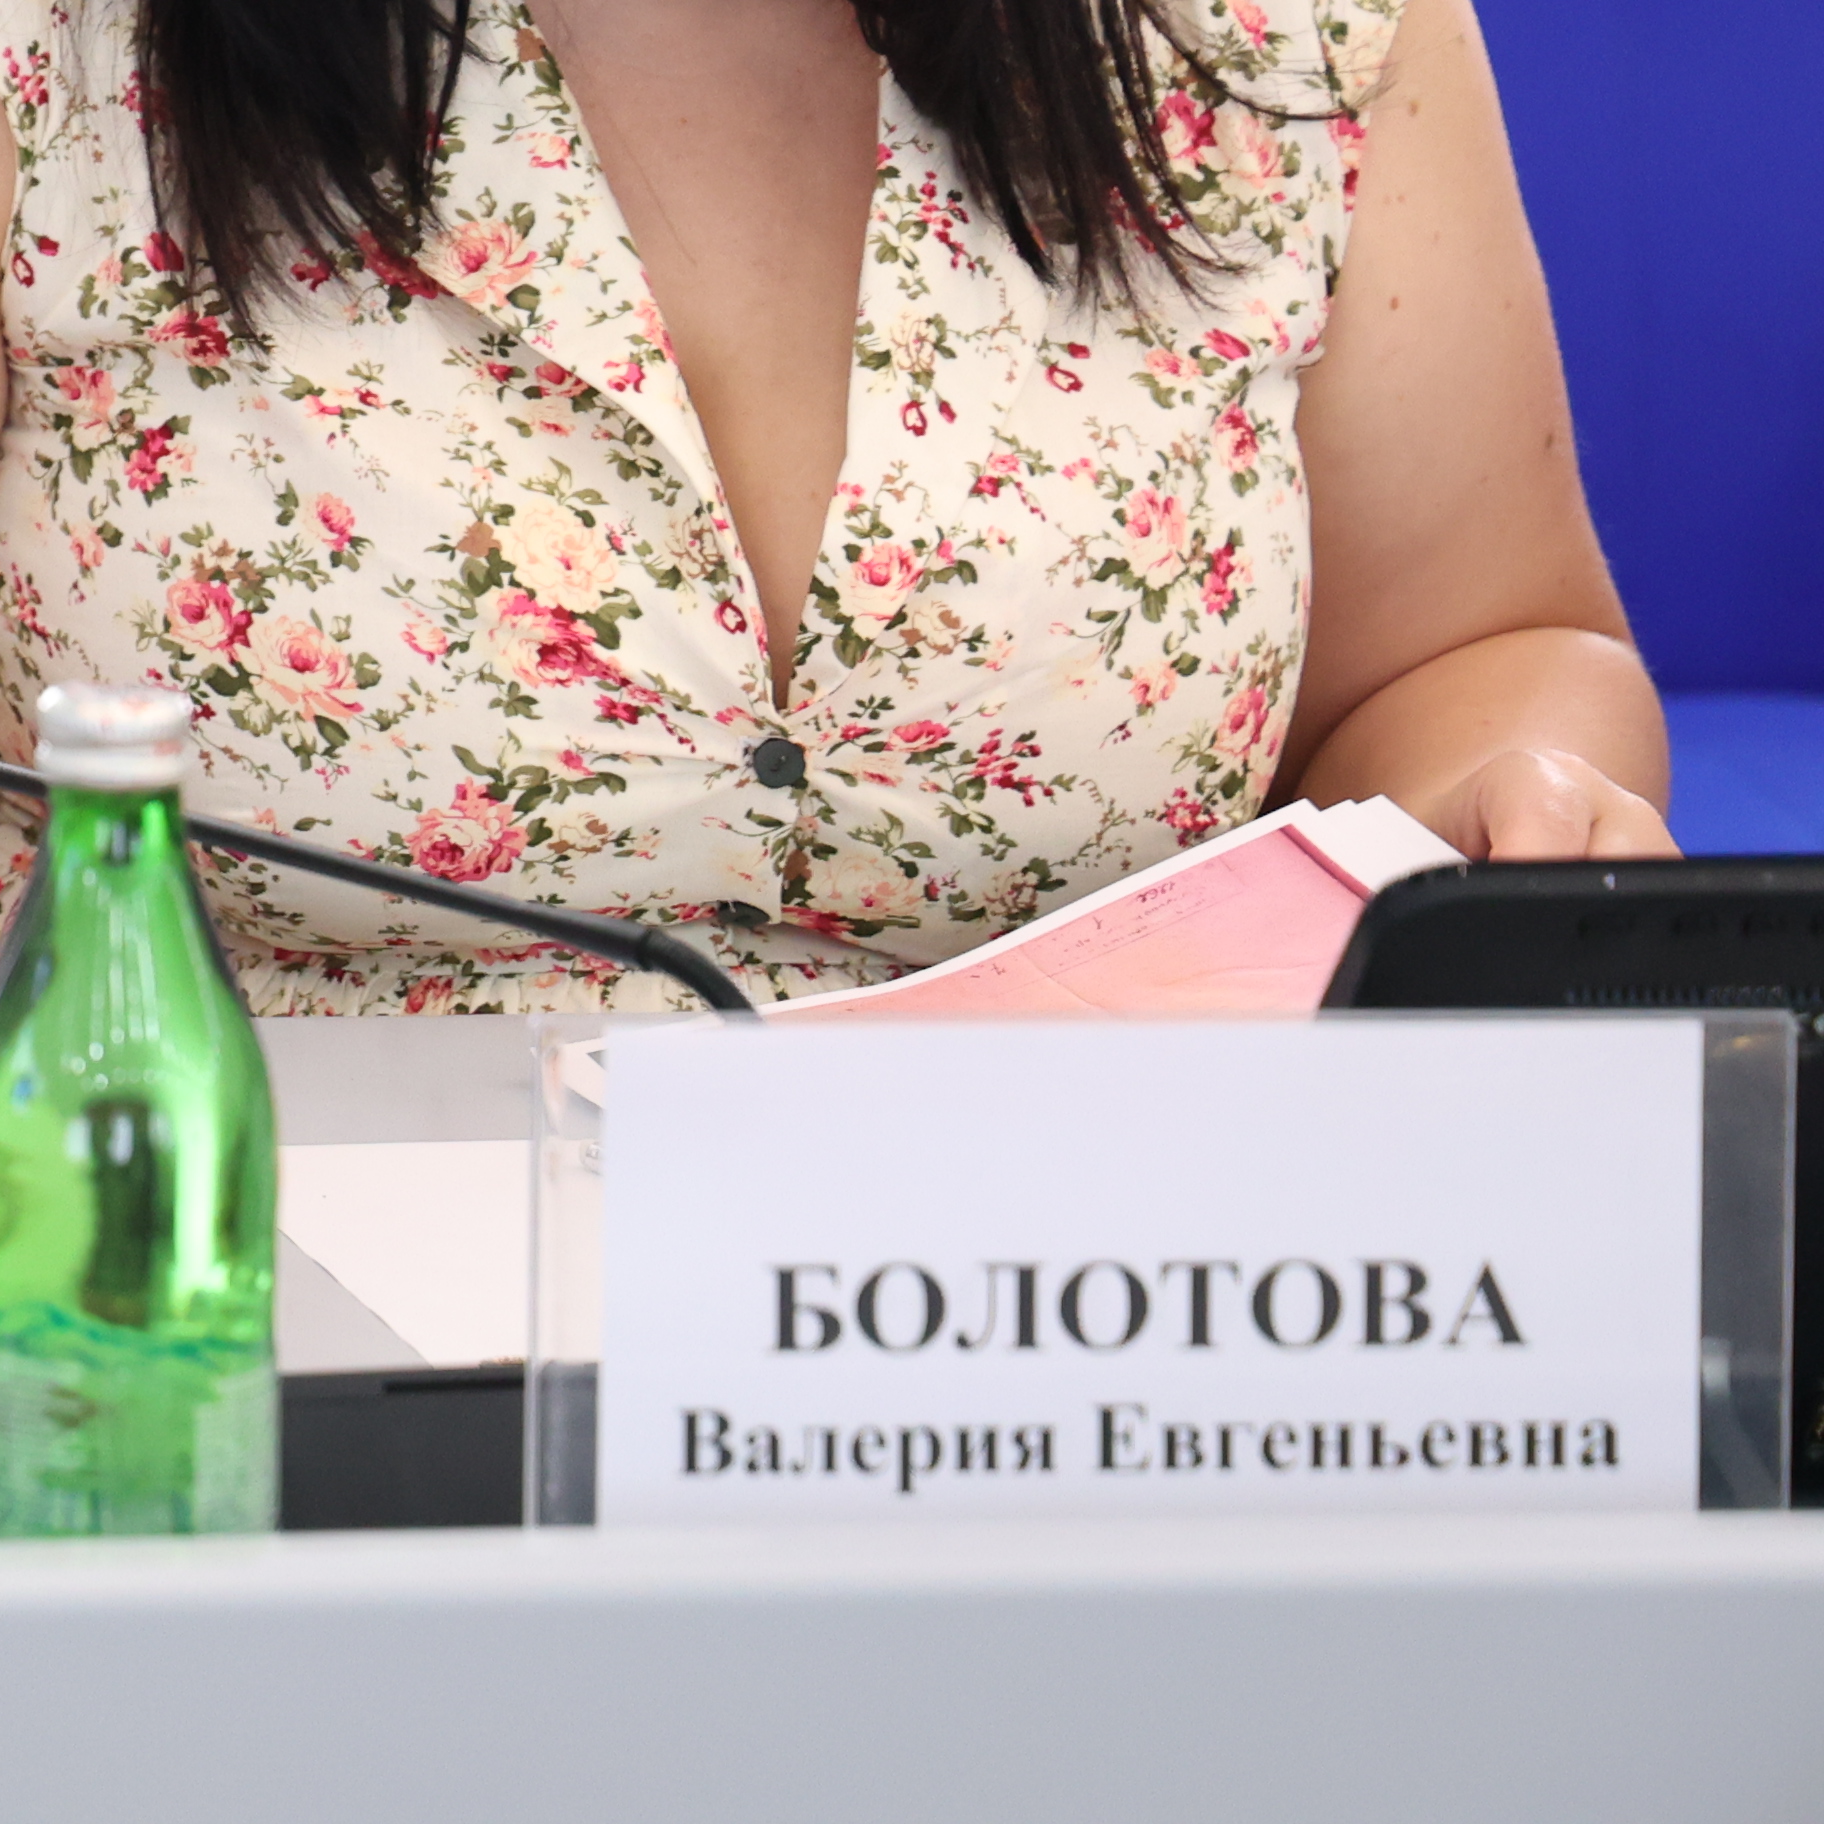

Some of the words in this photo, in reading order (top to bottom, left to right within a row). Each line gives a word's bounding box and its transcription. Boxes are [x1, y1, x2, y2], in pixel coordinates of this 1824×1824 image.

[768, 1258, 1529, 1353] БОЛОТОВА
[679, 1406, 1058, 1497] Валерия
[1095, 1403, 1623, 1473] Евгеньевна
